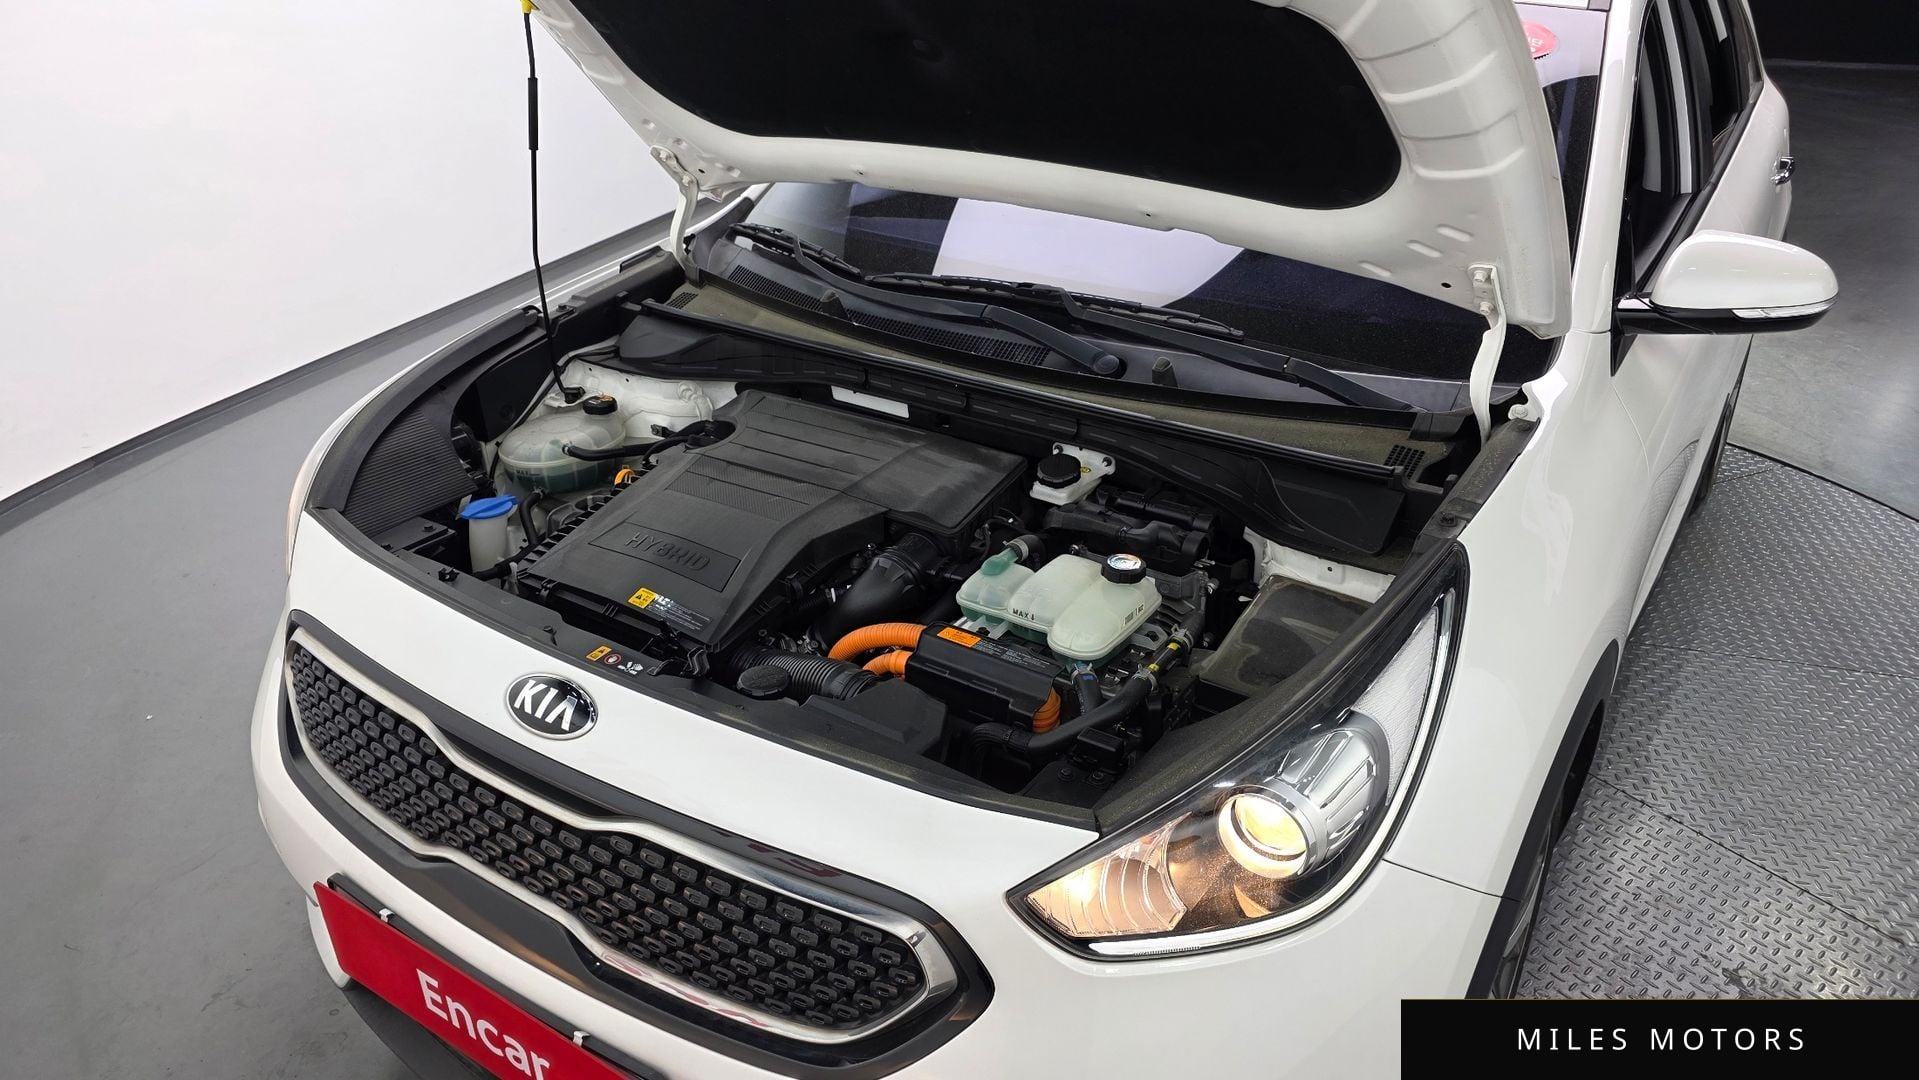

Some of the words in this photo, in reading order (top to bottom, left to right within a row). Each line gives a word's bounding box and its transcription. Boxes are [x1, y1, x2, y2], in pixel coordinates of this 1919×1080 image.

[625, 532, 711, 572] HYBRID
[1012, 607, 1030, 618] MAX
[513, 679, 578, 732] KIA
[416, 968, 551, 1080] Encar
